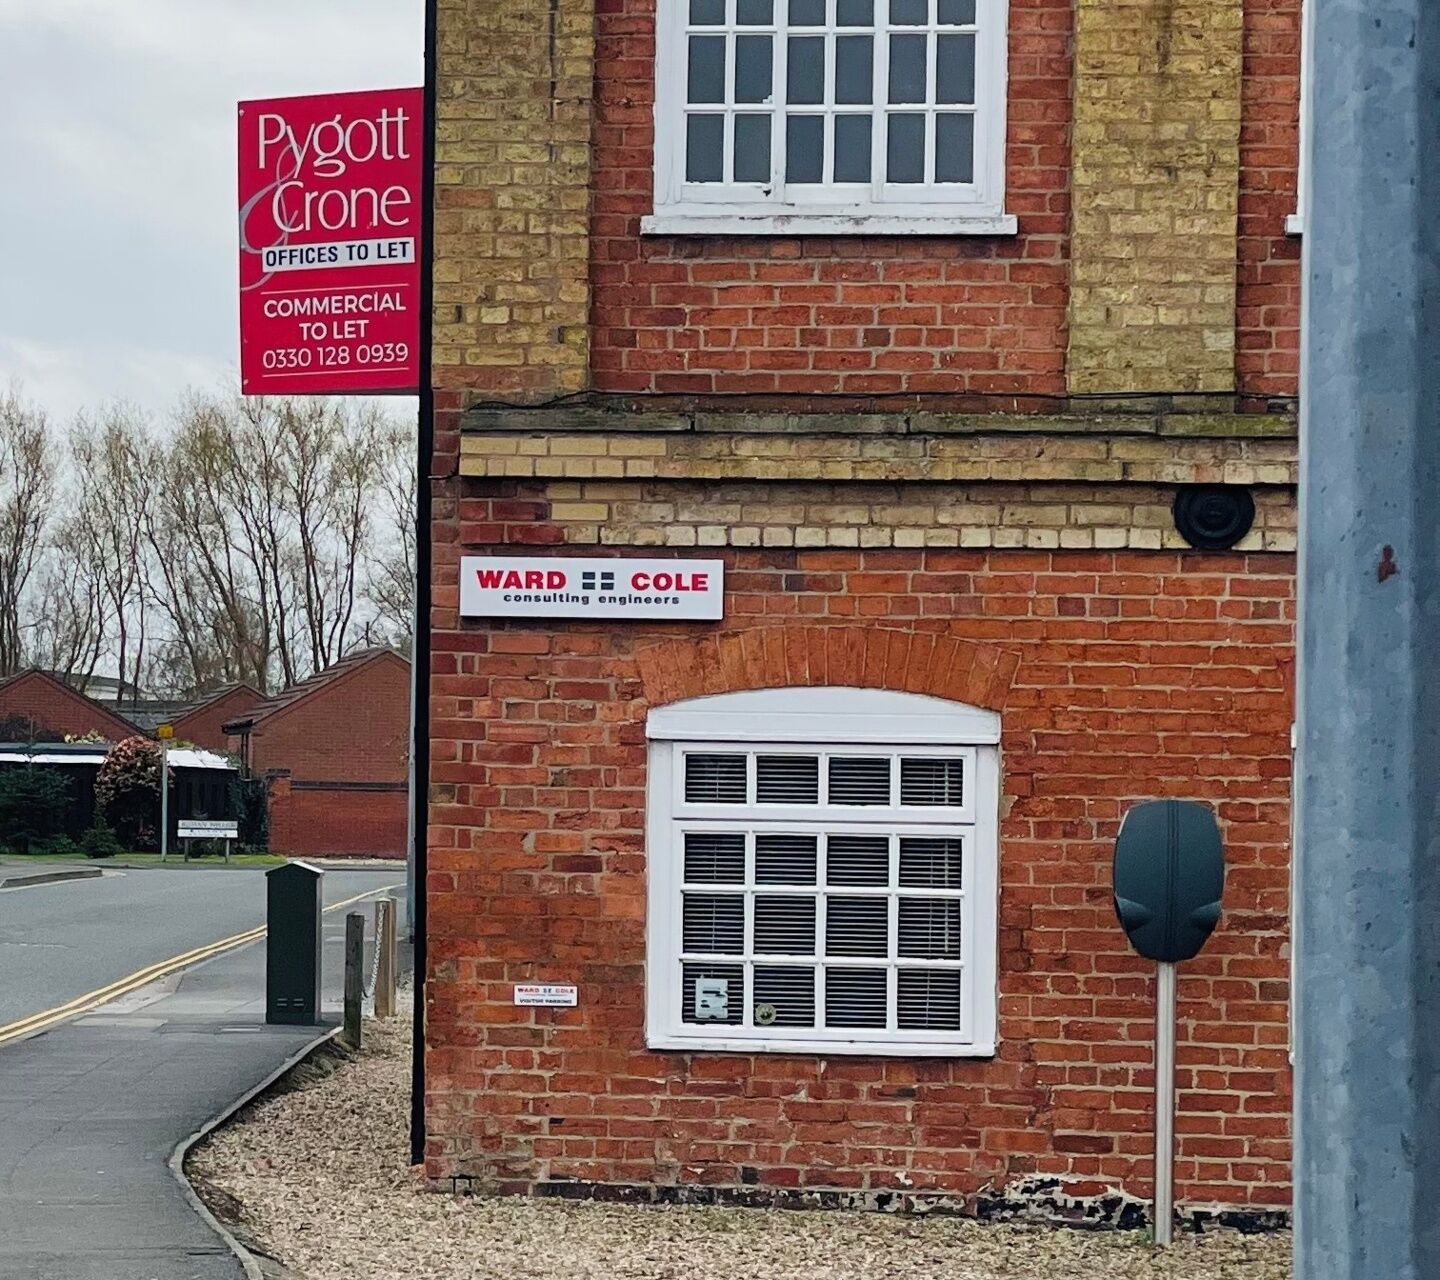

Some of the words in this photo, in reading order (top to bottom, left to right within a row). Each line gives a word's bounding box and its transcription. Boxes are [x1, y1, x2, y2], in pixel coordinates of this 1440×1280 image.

[258, 107, 410, 179] Pygott
[272, 181, 411, 233] Crone
[265, 246, 338, 267] OFFICES
[346, 243, 369, 261] TO
[377, 241, 410, 260] LET
[263, 292, 407, 318] COMMERCIAL
[299, 321, 329, 341] TO
[333, 319, 370, 340] LET
[262, 347, 312, 369] 0330
[317, 345, 351, 366] 128
[356, 342, 409, 364] 0939
[476, 569, 567, 590] WARD
[630, 572, 709, 592] COLE
[503, 592, 590, 605] consulting
[598, 594, 681, 606] engineers
